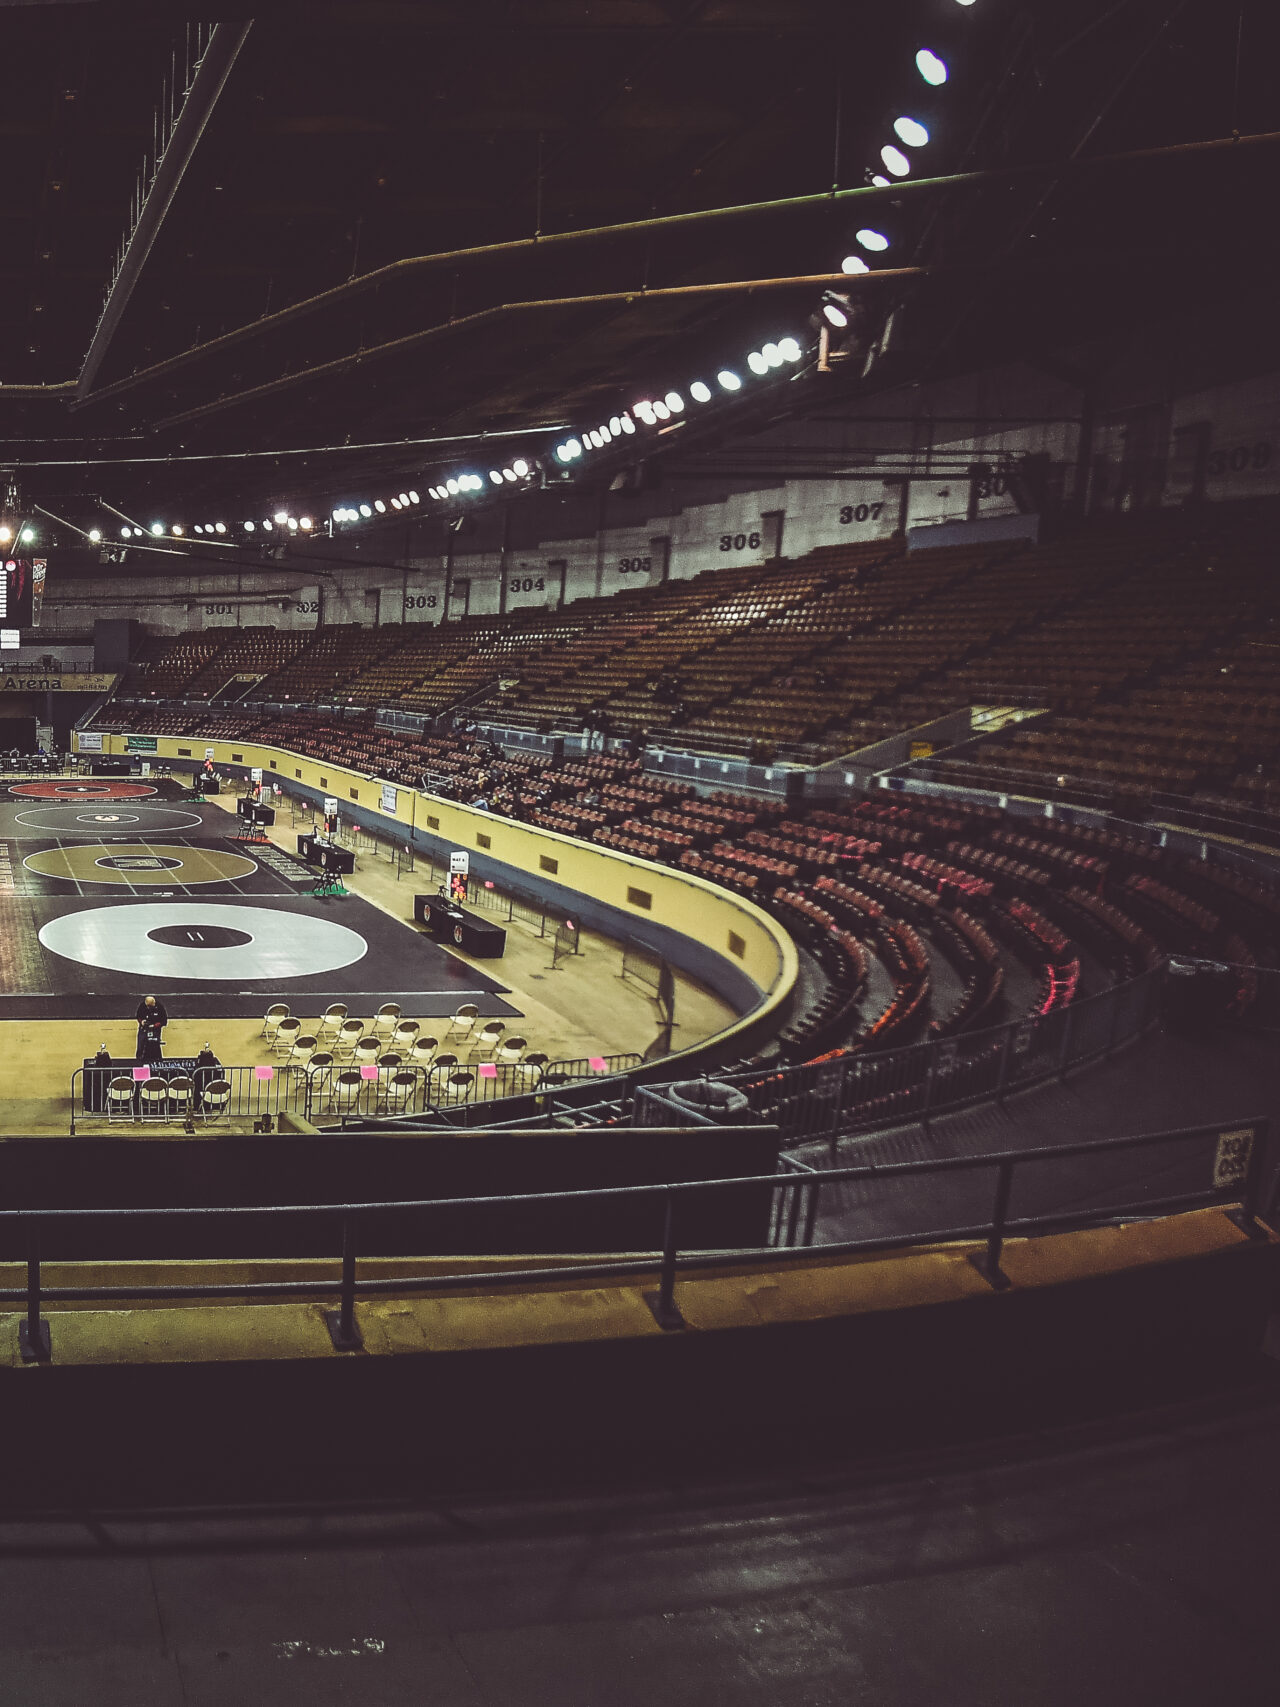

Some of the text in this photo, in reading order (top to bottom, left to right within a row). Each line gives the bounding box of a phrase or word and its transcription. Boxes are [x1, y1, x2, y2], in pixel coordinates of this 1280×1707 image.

[977, 477, 1008, 498] 30
[839, 502, 884, 525] 307
[720, 532, 761, 552] 306
[620, 556, 651, 574] 305
[510, 577, 545, 594] 304
[205, 602, 234, 615] 301
[405, 595, 438, 609] 303
[4, 676, 62, 690] Arena
